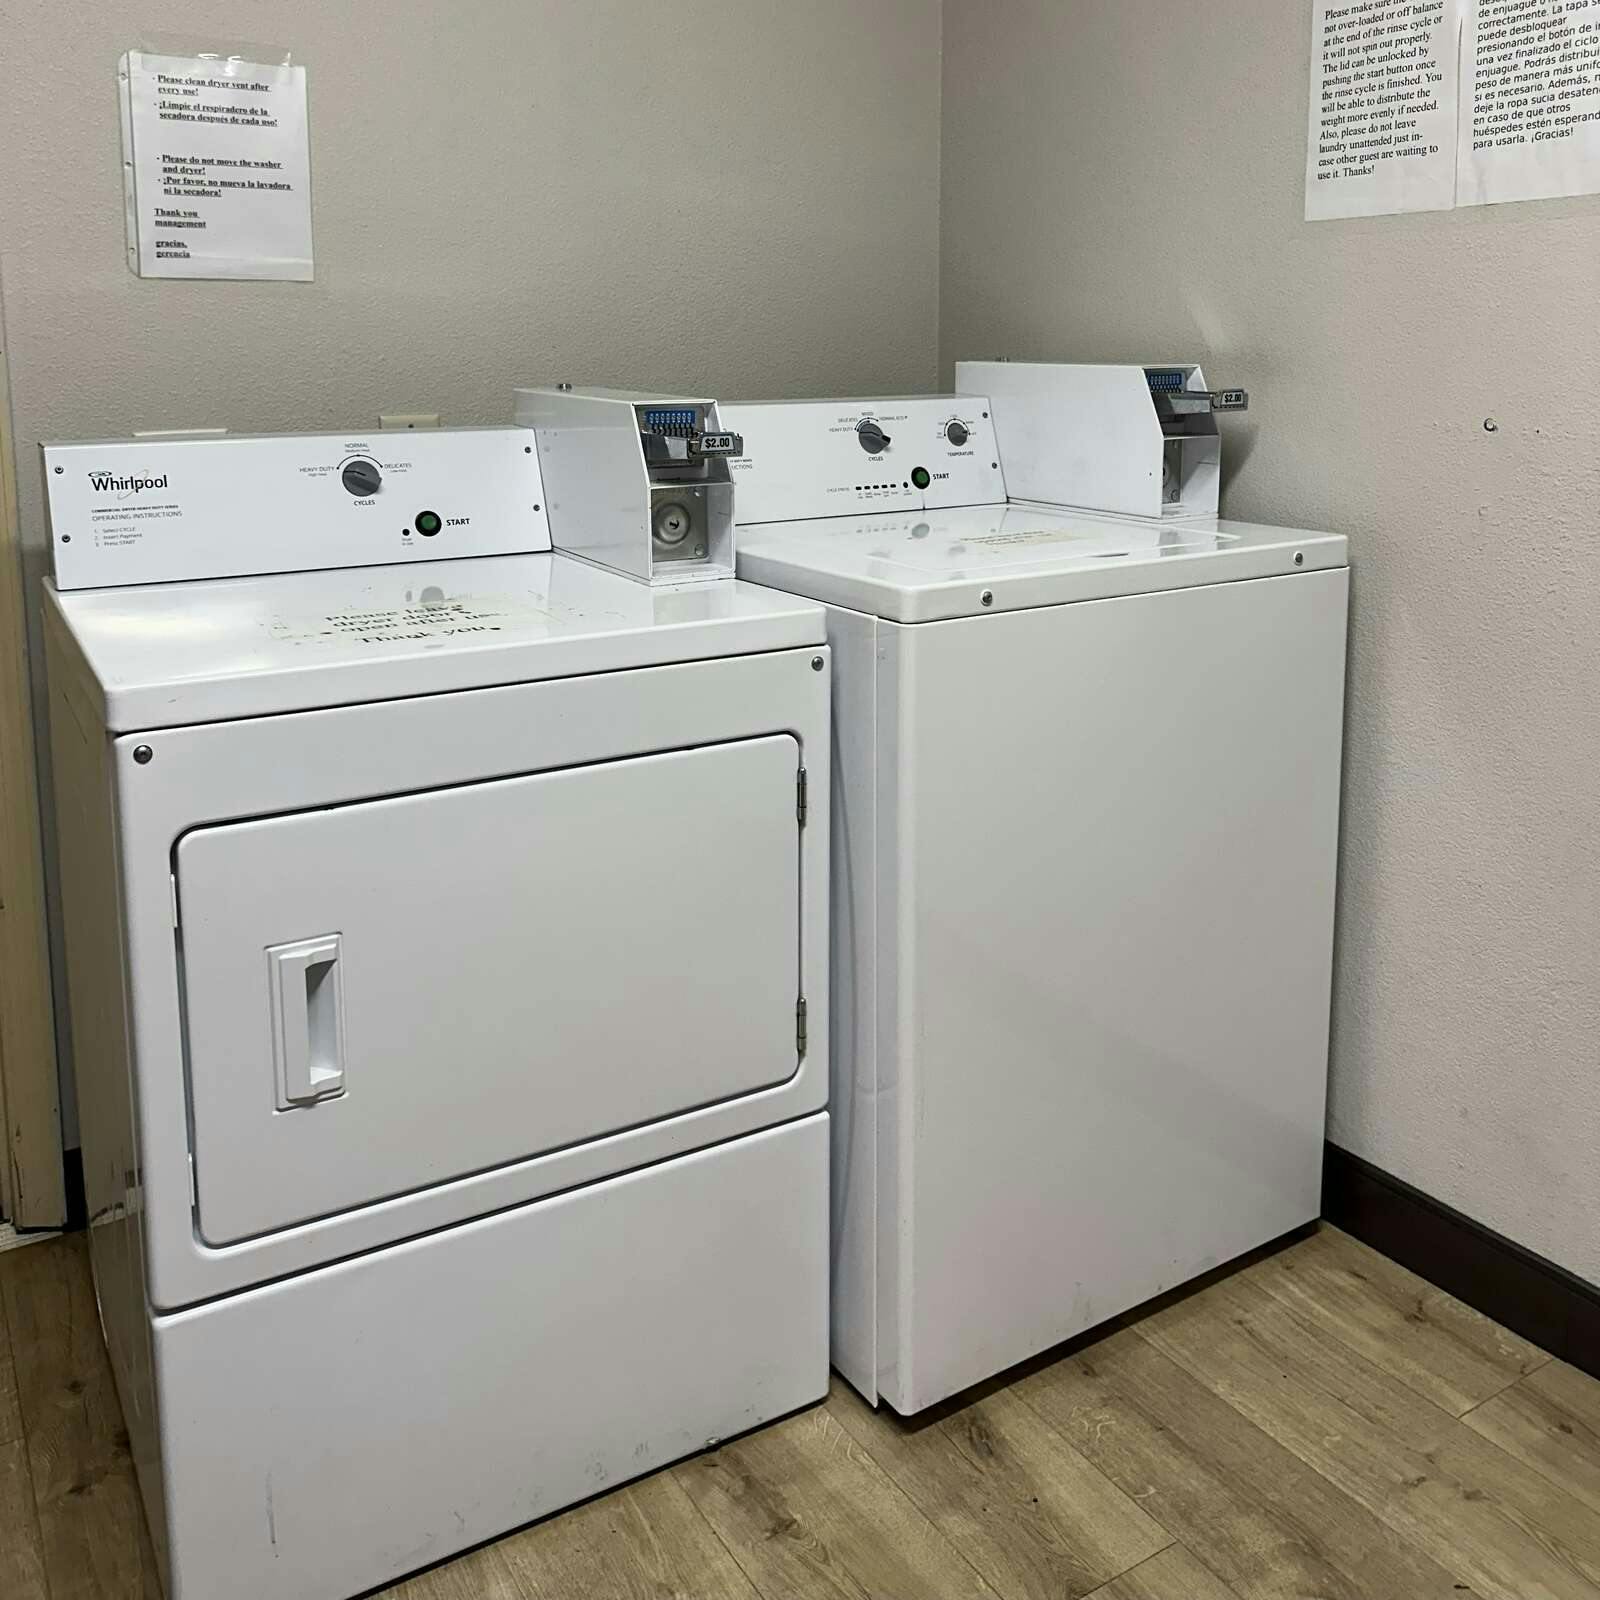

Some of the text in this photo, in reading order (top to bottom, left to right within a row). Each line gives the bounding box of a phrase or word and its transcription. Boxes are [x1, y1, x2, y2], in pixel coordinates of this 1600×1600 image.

[1325, 1, 1391, 19] Please make sure
[1478, 11, 1549, 29] correctamente.
[1566, 1, 1588, 10] tapa
[1493, 1, 1537, 14] enjuague
[1324, 3, 1443, 33] not over-loaded off balance
[1333, 18, 1432, 44] the end the rinse cycle
[1477, 19, 1567, 43] puede desbloquear
[1330, 33, 1432, 58] will not spin out properly.
[1476, 57, 1494, 65] una
[1515, 44, 1561, 58] finalizado
[1575, 37, 1598, 47] ciclo
[1477, 37, 1535, 55] presionando
[1549, 29, 1575, 39] botón
[1323, 64, 1338, 73] The
[1340, 61, 1350, 70] lid
[1378, 48, 1416, 63] unlocked
[1419, 47, 1429, 56] by
[1476, 65, 1520, 77] enjuague.
[1524, 57, 1556, 68] Podrás
[158, 75, 182, 84] Please
[185, 78, 205, 86] clean
[208, 79, 229, 88] dryer
[251, 82, 269, 90] after
[1323, 61, 1436, 88] pushing the start button once
[1475, 80, 1497, 91] peso
[1514, 72, 1550, 82] manera
[1553, 67, 1573, 75] más
[158, 87, 179, 95] every
[1322, 91, 1333, 100] the
[1335, 90, 1353, 98] rinse
[1355, 84, 1376, 96] cycle
[1387, 77, 1422, 89] finished.
[1498, 77, 1590, 97] necesario. Además,
[1321, 89, 1430, 112] will able distribute the
[1474, 95, 1555, 113] deje ropa sucia
[160, 112, 195, 120] secadora
[1321, 102, 1438, 126] weight more evenly needed.
[1526, 110, 1544, 119] que
[1547, 106, 1570, 114] otros
[1320, 131, 1339, 140] Also,
[1341, 128, 1366, 139] please
[1380, 123, 1392, 131] not
[1473, 124, 1523, 136] huéspedes
[1526, 120, 1551, 129] estén
[1319, 143, 1347, 153] laundry
[1349, 136, 1392, 149] unattended
[1394, 135, 1409, 146] just
[1473, 129, 1573, 150] para usarla. ¡Gracias!
[163, 155, 187, 163] Please
[240, 158, 252, 166] the
[1336, 155, 1357, 163] other
[1359, 152, 1379, 163] guest
[1395, 148, 1427, 157] waiting
[180, 166, 205, 175] dryer!
[1343, 166, 1374, 176] Thanks!
[184, 188, 221, 196] secadora!
[257, 181, 291, 189] lavadora
[156, 251, 190, 259] gerencia
[705, 438, 730, 448] $2.00
[91, 475, 168, 493] Whirlpool
[133, 511, 182, 519] INSTRUCTIONS
[446, 518, 470, 526] START
[443, 627, 485, 635] you
